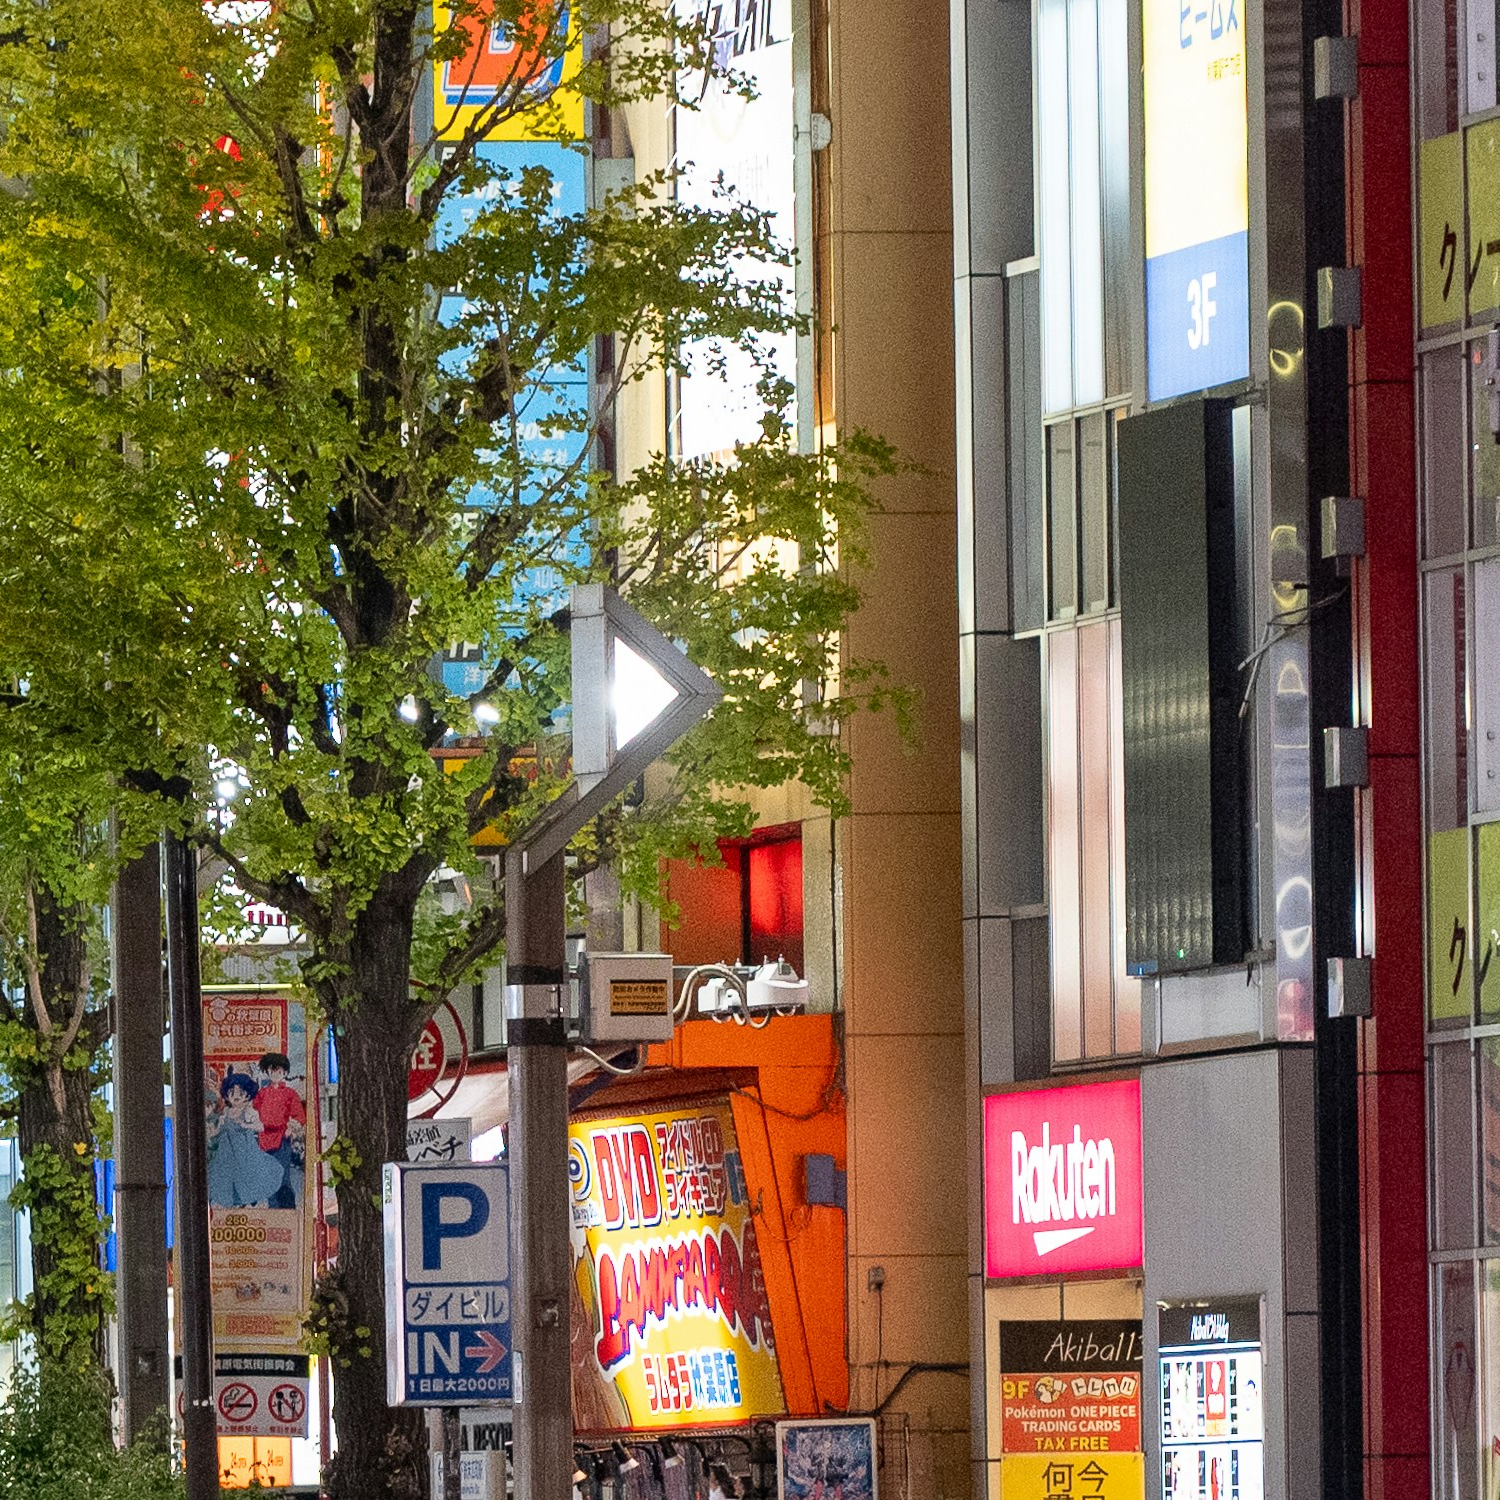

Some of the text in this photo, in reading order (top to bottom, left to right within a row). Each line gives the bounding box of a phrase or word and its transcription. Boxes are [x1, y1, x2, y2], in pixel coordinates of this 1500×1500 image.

[1187, 271, 1217, 350] 3F
[592, 1125, 663, 1231] DVD
[1012, 1121, 1116, 1224] Rakuten
[421, 1182, 490, 1271] P
[411, 1291, 505, 1322] ダイビル
[408, 1332, 460, 1375] IN
[409, 1378, 510, 1393] 1日最大2000円
[1003, 1380, 1029, 1399] 9F
[1005, 1404, 1066, 1419] Pokémon
[1022, 1419, 1121, 1433] TRADING CARDS
[1035, 1436, 1108, 1451] TAX FREE
